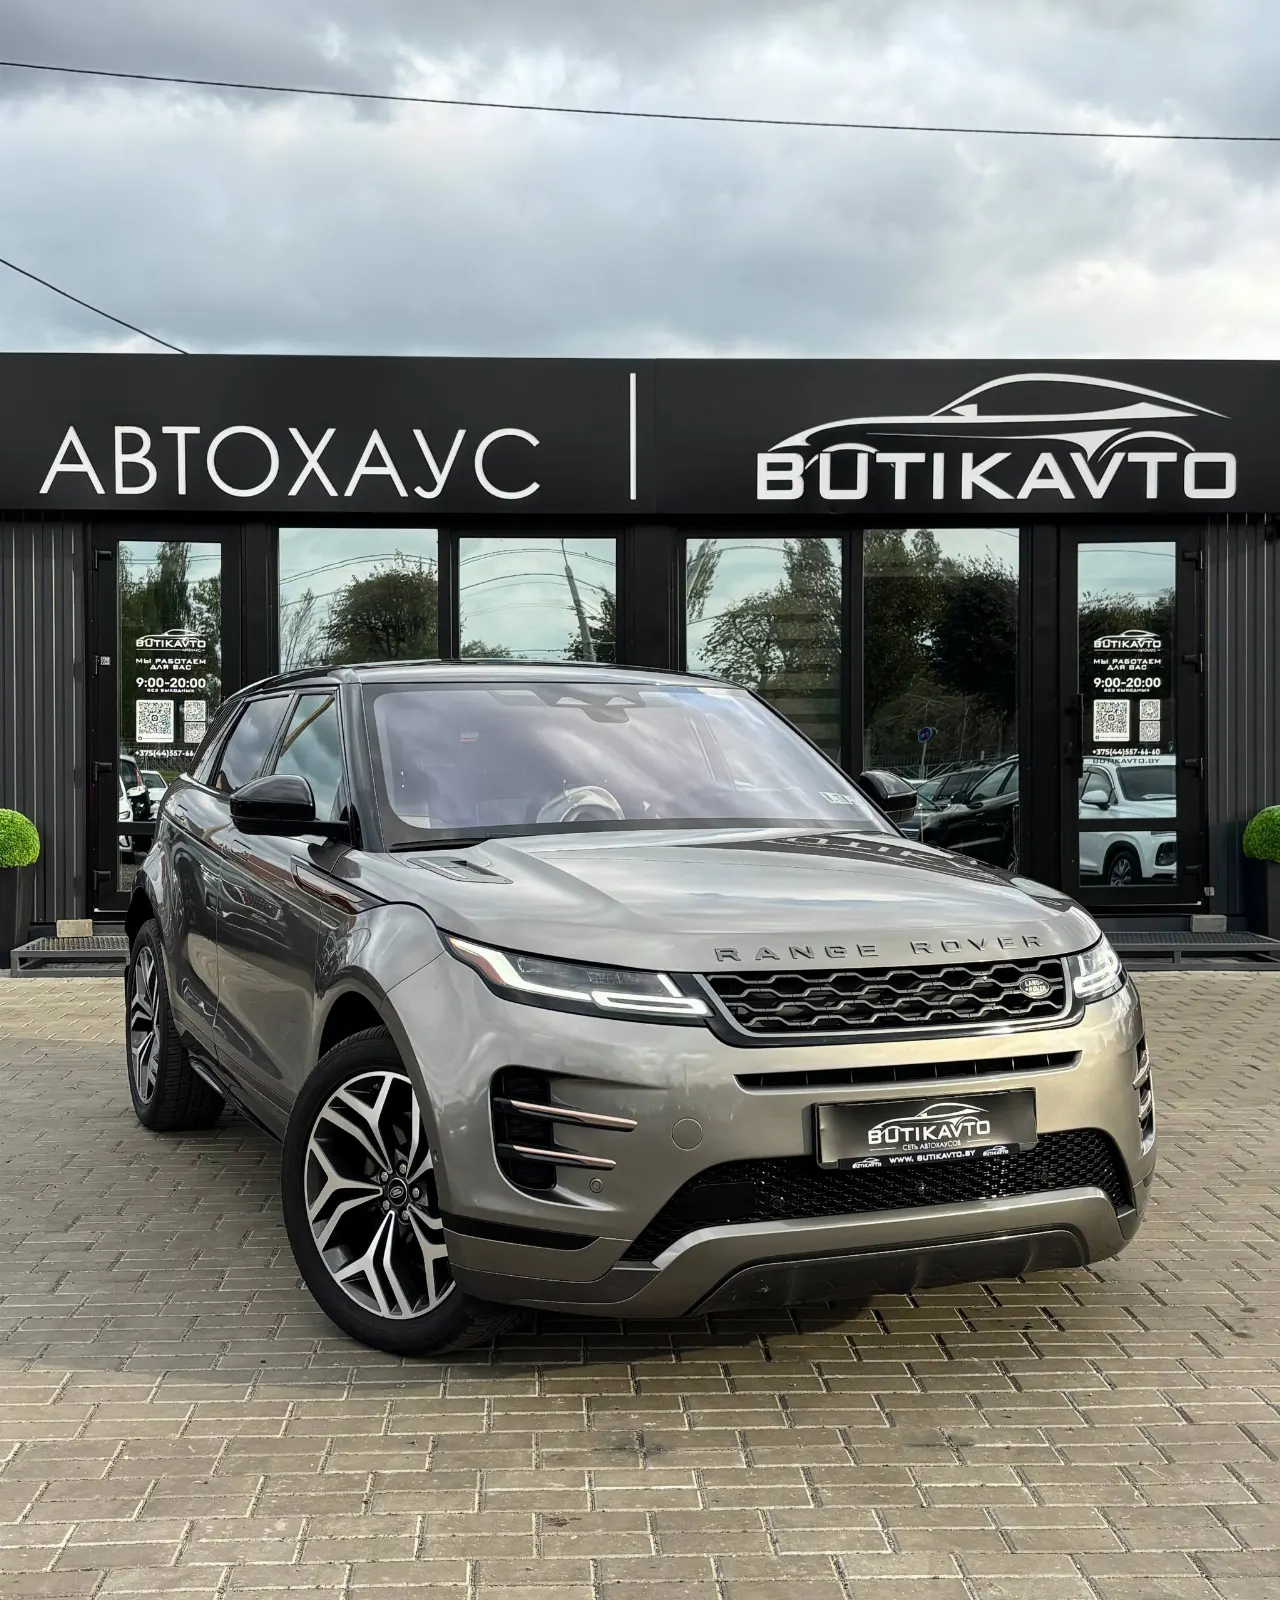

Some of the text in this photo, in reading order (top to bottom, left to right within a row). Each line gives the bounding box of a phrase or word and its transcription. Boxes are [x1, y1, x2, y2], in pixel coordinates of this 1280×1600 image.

[40, 425, 541, 500] АВТОХАУС
[756, 451, 1238, 500] BUTIKAVTO
[135, 639, 207, 648] BUTIKAVTO
[1093, 640, 1162, 649] BUTIKAVTO
[135, 677, 207, 689] 9:00-20:00
[1093, 677, 1161, 688] 9:00-20:00
[1092, 748, 1161, 757] +375(44)557-66-60
[713, 935, 1044, 962] RANGE ROVER
[867, 1120, 991, 1145] BUTIKAVTO
[919, 1140, 961, 1150] АВТОХАУСОВ
[889, 1155, 914, 1164] WWW.
